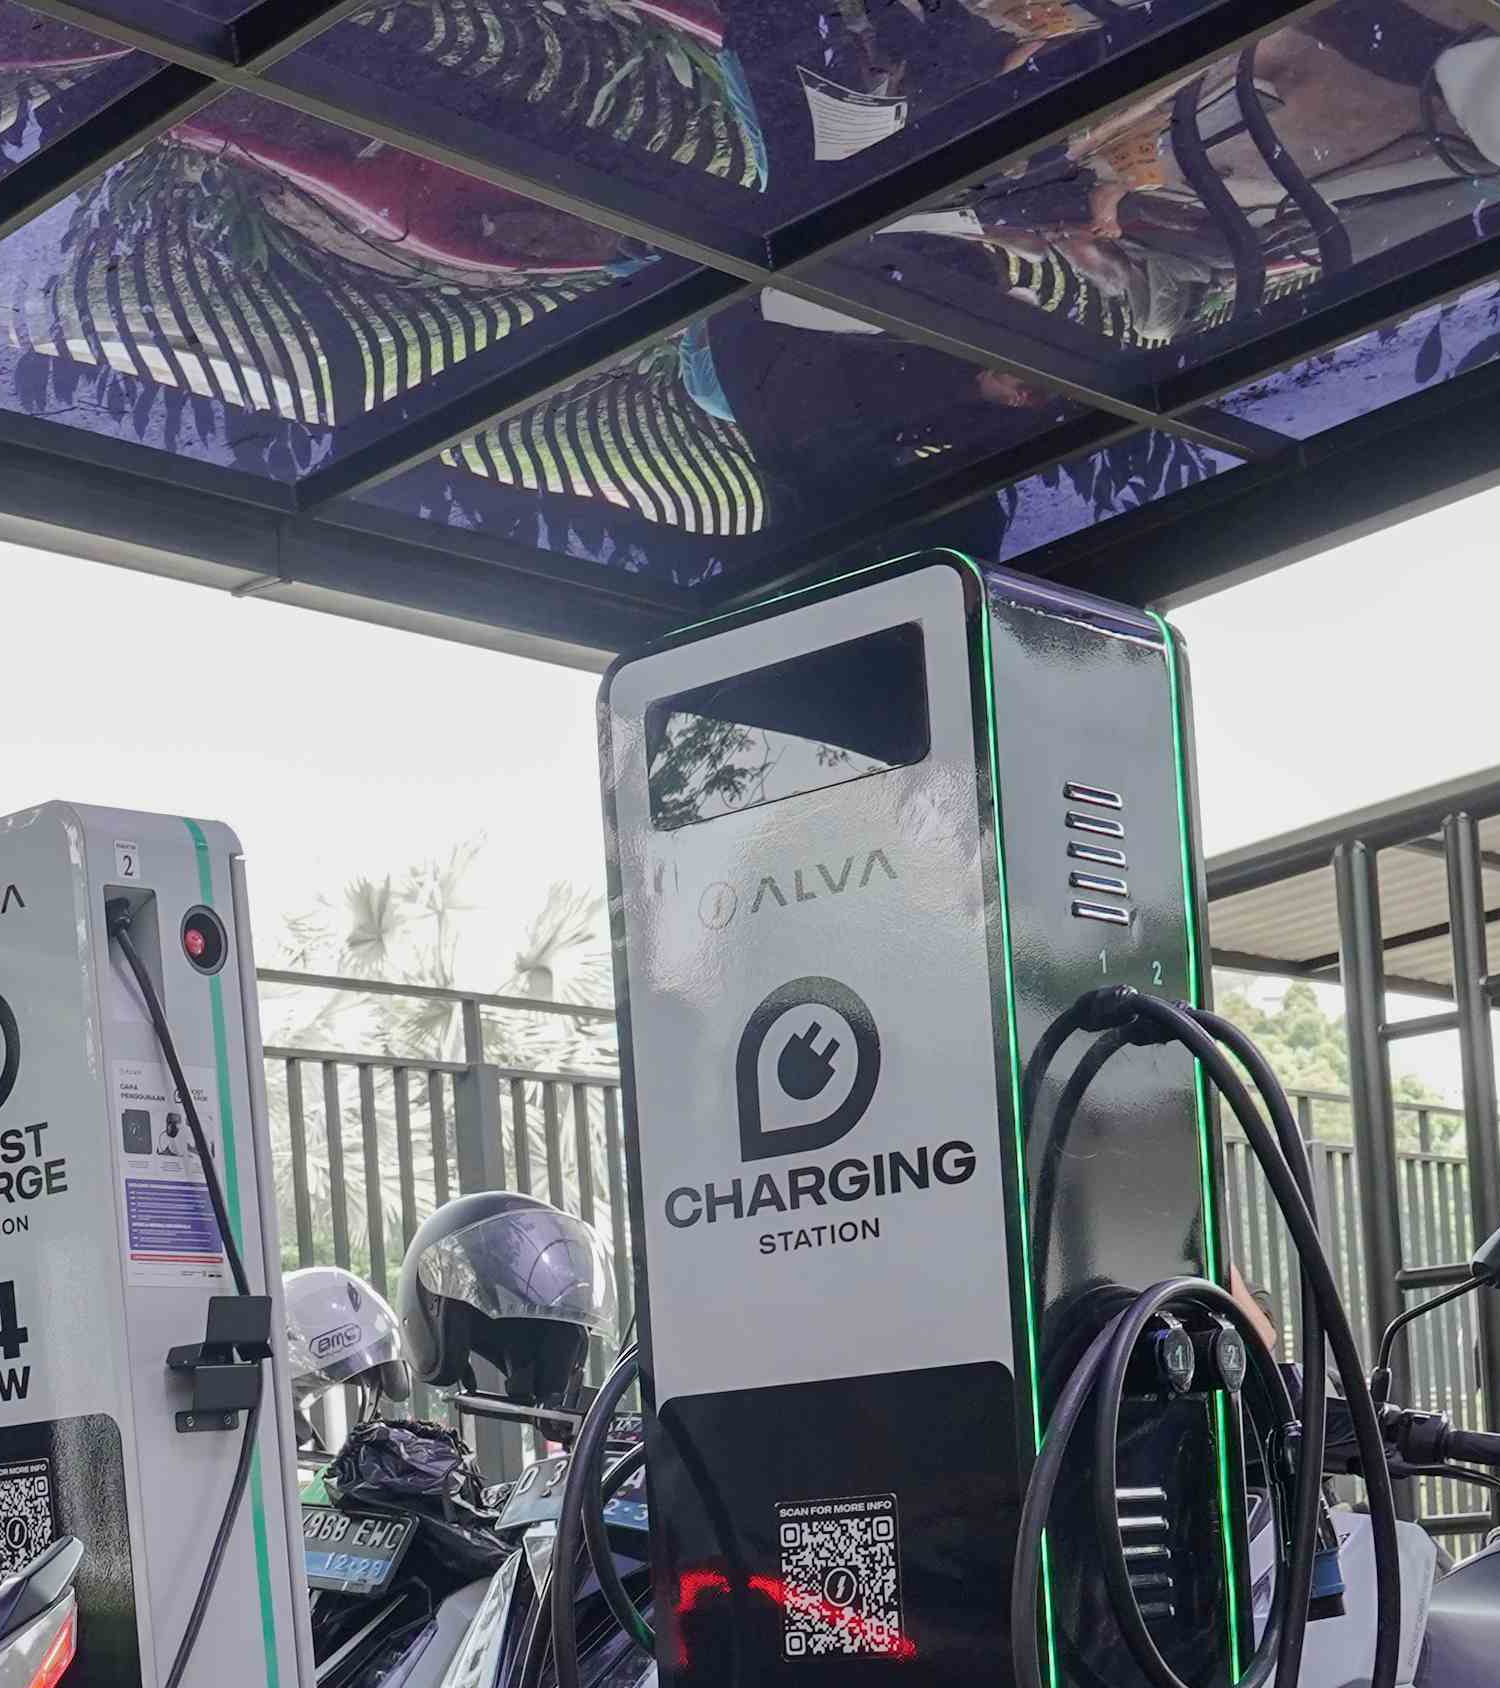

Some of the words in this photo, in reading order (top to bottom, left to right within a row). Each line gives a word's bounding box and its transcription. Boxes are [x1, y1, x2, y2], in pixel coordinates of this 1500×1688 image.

[122, 854, 134, 877] 2
[750, 848, 899, 915] ALVA
[1099, 949, 1107, 974] 1
[1151, 960, 1163, 985] 2
[663, 1140, 977, 1229] CHARGING
[758, 1216, 880, 1256] STATION
[10, 1465, 30, 1476] MORE
[779, 1507, 809, 1518] SCAN
[810, 1504, 832, 1516] FOR
[833, 1502, 865, 1514] MORE
[866, 1499, 893, 1511] INFO
[352, 1518, 405, 1550] EWC
